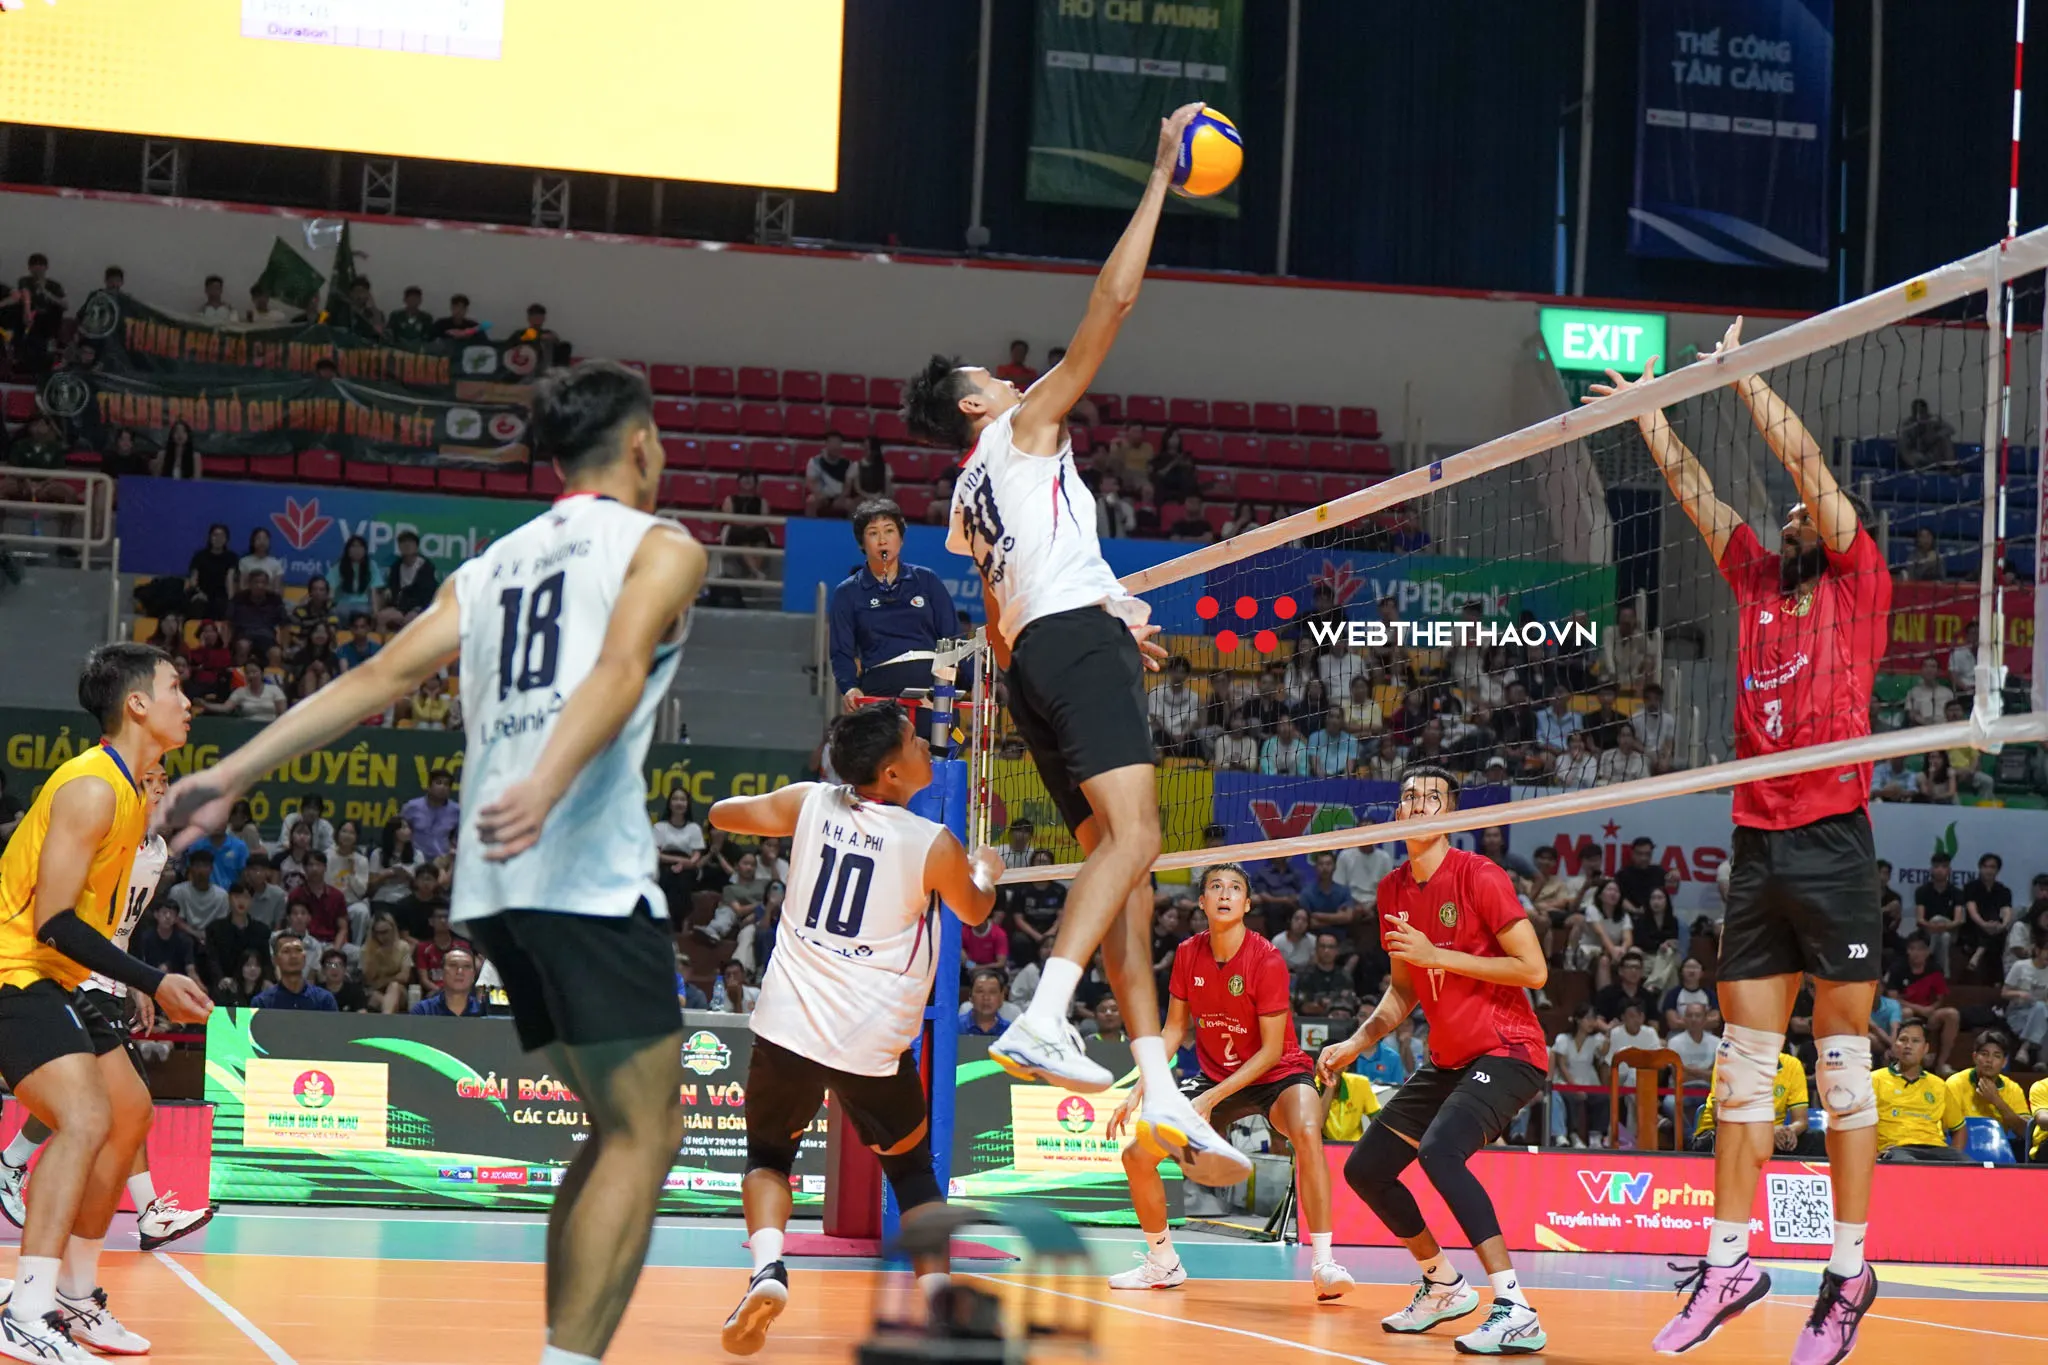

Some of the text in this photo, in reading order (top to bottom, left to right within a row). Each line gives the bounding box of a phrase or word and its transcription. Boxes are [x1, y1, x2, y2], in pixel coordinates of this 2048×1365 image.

[267, 22, 329, 39] Duration
[1152, 5, 1220, 29] MINH
[1728, 34, 1792, 62] CÔNG
[1671, 59, 1723, 86] TÂN
[1562, 322, 1644, 362] EXIT
[338, 518, 490, 560] VPBank
[1370, 578, 1512, 618] VPBank
[497, 570, 566, 702] 18
[164, 744, 221, 778] NG
[260, 740, 398, 788] HUYỀN
[645, 758, 716, 804] UỐC
[344, 797, 402, 828] PHÂ
[833, 825, 844, 843] H.
[848, 831, 860, 847] A.
[863, 834, 885, 852] PHI
[1551, 818, 1727, 883] MIAS
[123, 886, 149, 923] 14
[804, 843, 876, 939] 10
[1427, 968, 1446, 1002] 17
[1221, 1033, 1238, 1061] 2
[456, 1071, 509, 1100] GIẢI
[705, 1080, 746, 1107] VÔ
[513, 1107, 543, 1125] CÁC
[547, 1108, 578, 1126] CÂU
[683, 1112, 713, 1130] HÂN
[717, 1113, 748, 1131] BÓN
[1577, 1170, 1715, 1211] VTV prim
[1546, 1210, 1593, 1229] Truyền
[1593, 1210, 1621, 1228] hình
[1634, 1209, 1660, 1229] Thể
[1661, 1214, 1693, 1230] thao
